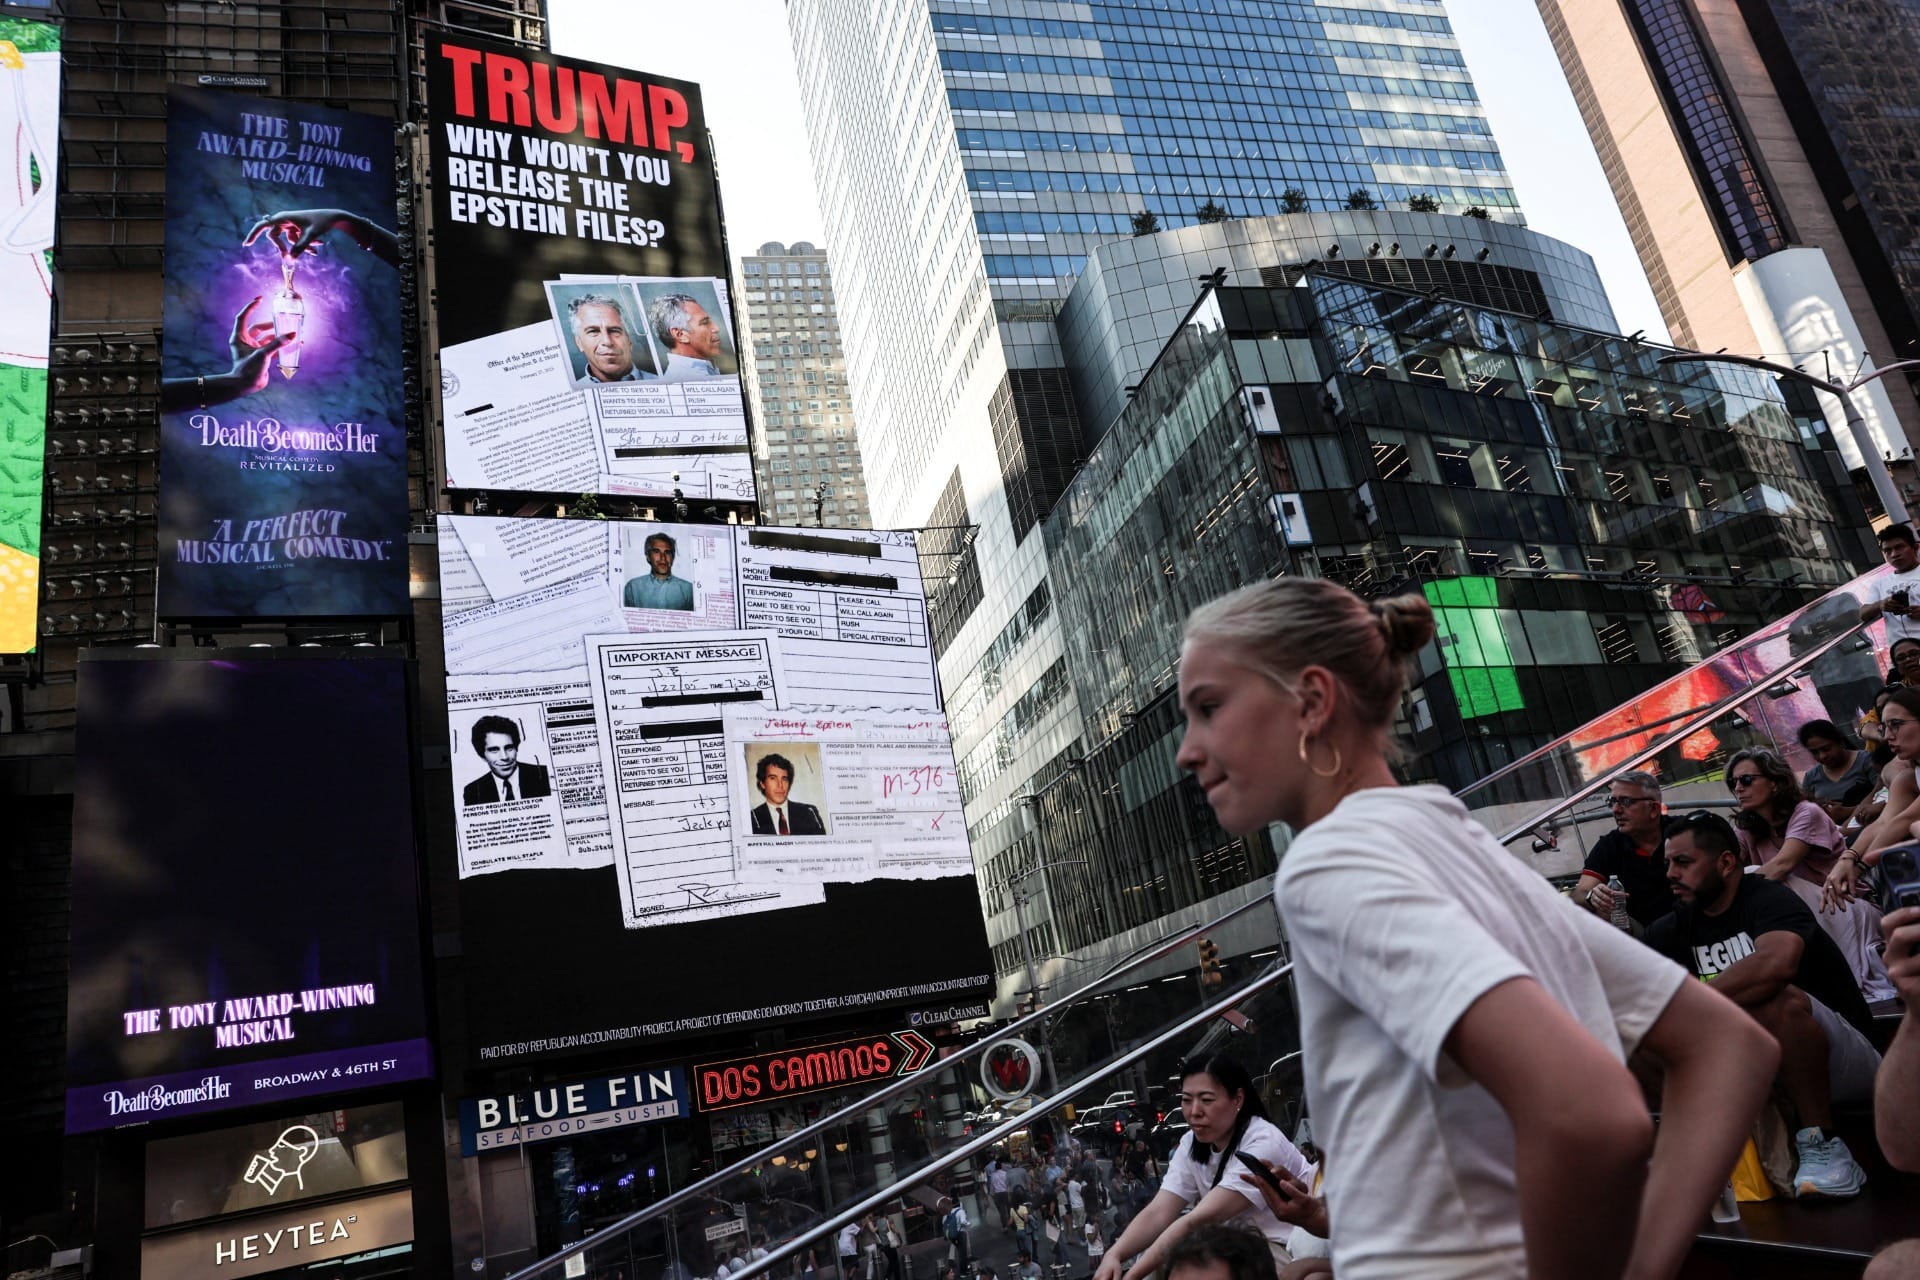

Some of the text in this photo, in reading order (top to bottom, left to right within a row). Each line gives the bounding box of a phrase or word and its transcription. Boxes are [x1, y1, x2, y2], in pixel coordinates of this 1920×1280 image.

[441, 44, 694, 163] TRUMP,
[241, 112, 342, 148] THE TONY
[198, 132, 371, 172] AWARD-WINNING
[445, 123, 670, 186] WHY WON'T YOU
[242, 160, 324, 187] MUSICAL
[448, 157, 629, 211] RELEASE THE
[450, 191, 664, 247] EPSTEIN FILES?
[190, 414, 379, 453] Death Becomes Her
[240, 461, 335, 472] REVITALIZED
[242, 509, 346, 543] PERFECT
[177, 539, 274, 564] MUSICAL
[747, 588, 793, 598] TELEPHONED
[747, 601, 767, 609] CAME
[839, 596, 864, 604] PLEASE
[840, 608, 856, 616] WILL
[842, 632, 906, 643] SPECIAL ATTENTION
[614, 648, 756, 663] IMPORTANT MESSAGE
[620, 746, 662, 755] TELEPHONED
[624, 780, 656, 788] RETURNED
[624, 800, 655, 809] MESSAGE
[640, 905, 665, 913] SIGNED
[124, 983, 375, 1035] THE TONY AWARD-WINNING
[215, 1017, 295, 1049] MUSICAL
[481, 1046, 500, 1059] PAID
[500, 1044, 517, 1057] FOR
[517, 1042, 529, 1054] BY
[530, 1035, 579, 1053] REPUBLICAN
[579, 1025, 641, 1045] ACCOUNTABILITY
[682, 1015, 712, 1029] PROJECT
[713, 1015, 722, 1025] OF
[254, 1059, 398, 1090] BROADWAY & 46TH ST
[703, 1042, 891, 1104] DOS CAMINOS
[104, 1075, 232, 1116] Death Becomes Her
[478, 1070, 673, 1129] BLUE FIN
[481, 1104, 676, 1146] SEAFOOD SUSHI
[216, 1218, 350, 1265] HEYTEA
